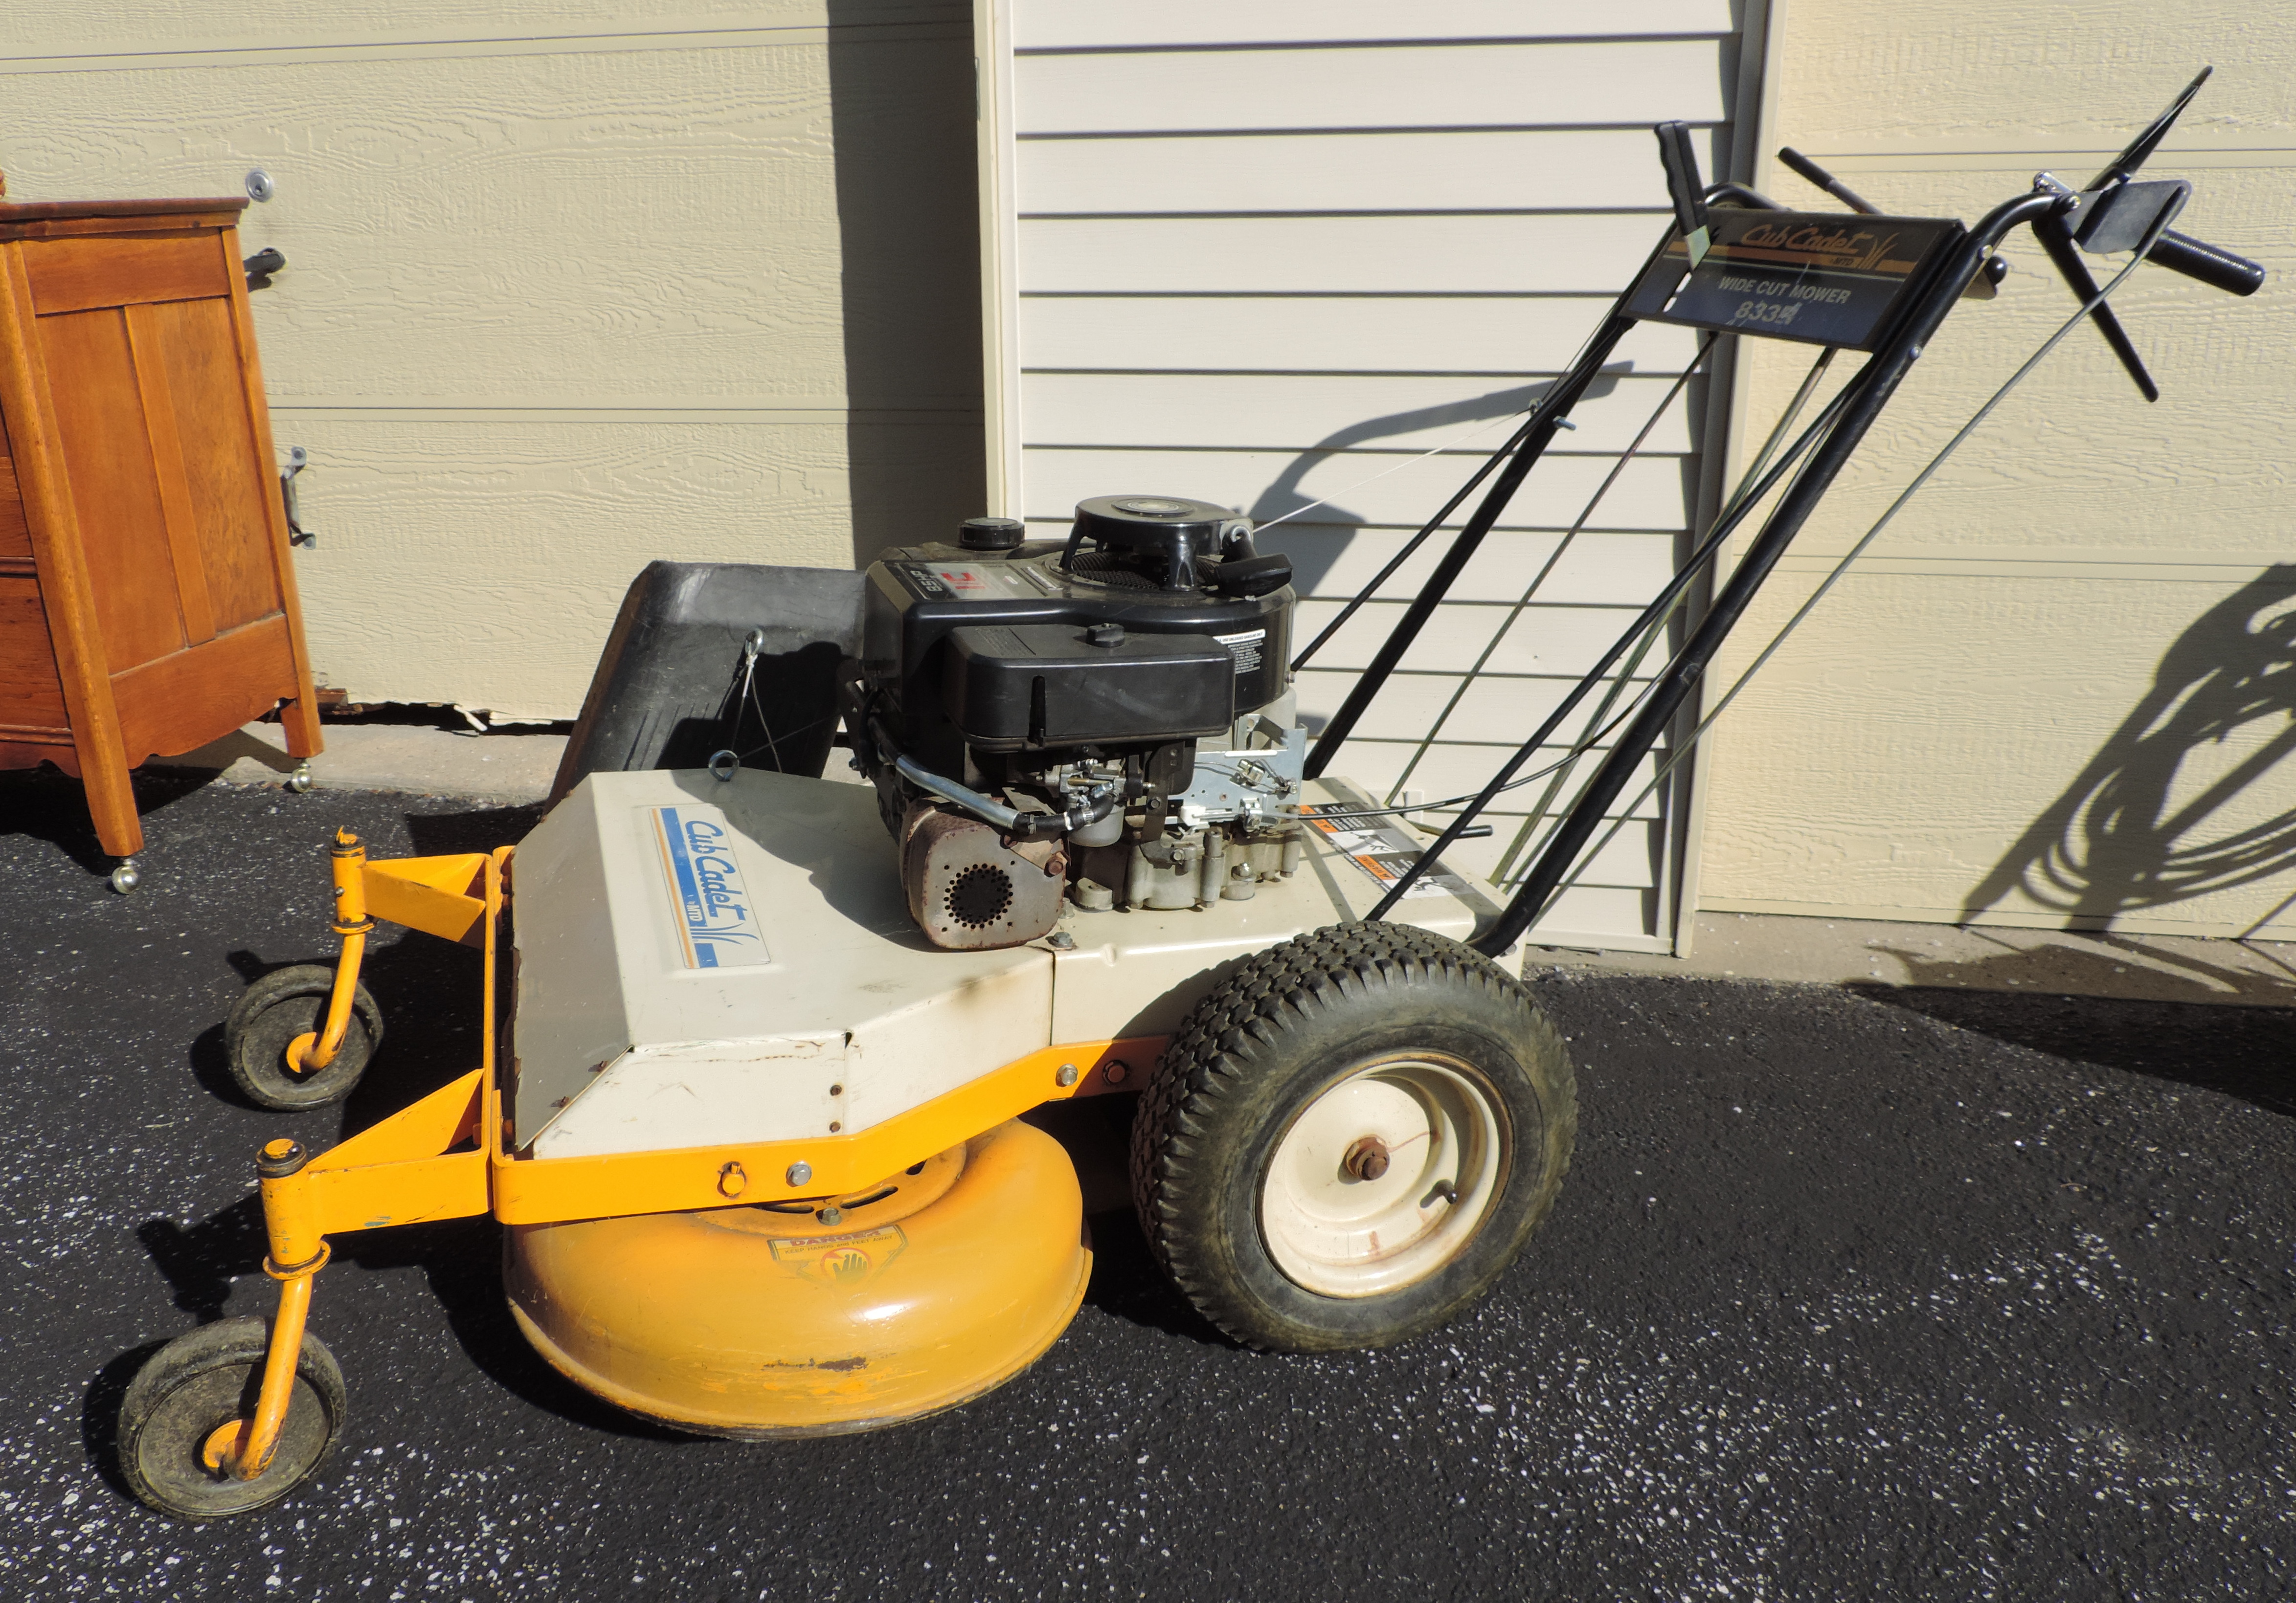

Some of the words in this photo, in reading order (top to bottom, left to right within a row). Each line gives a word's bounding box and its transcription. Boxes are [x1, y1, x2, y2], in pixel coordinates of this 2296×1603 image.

[1741, 223, 1792, 248] Cub
[1786, 226, 1874, 254] Cadet
[1718, 276, 1757, 292] WIDE
[1756, 280, 1791, 296] CUT
[1788, 284, 1851, 304] MOWER
[685, 820, 728, 854] Cub
[695, 856, 748, 921] Cadet
[686, 905, 703, 921] MTD
[790, 1230, 881, 1247] DANGER
